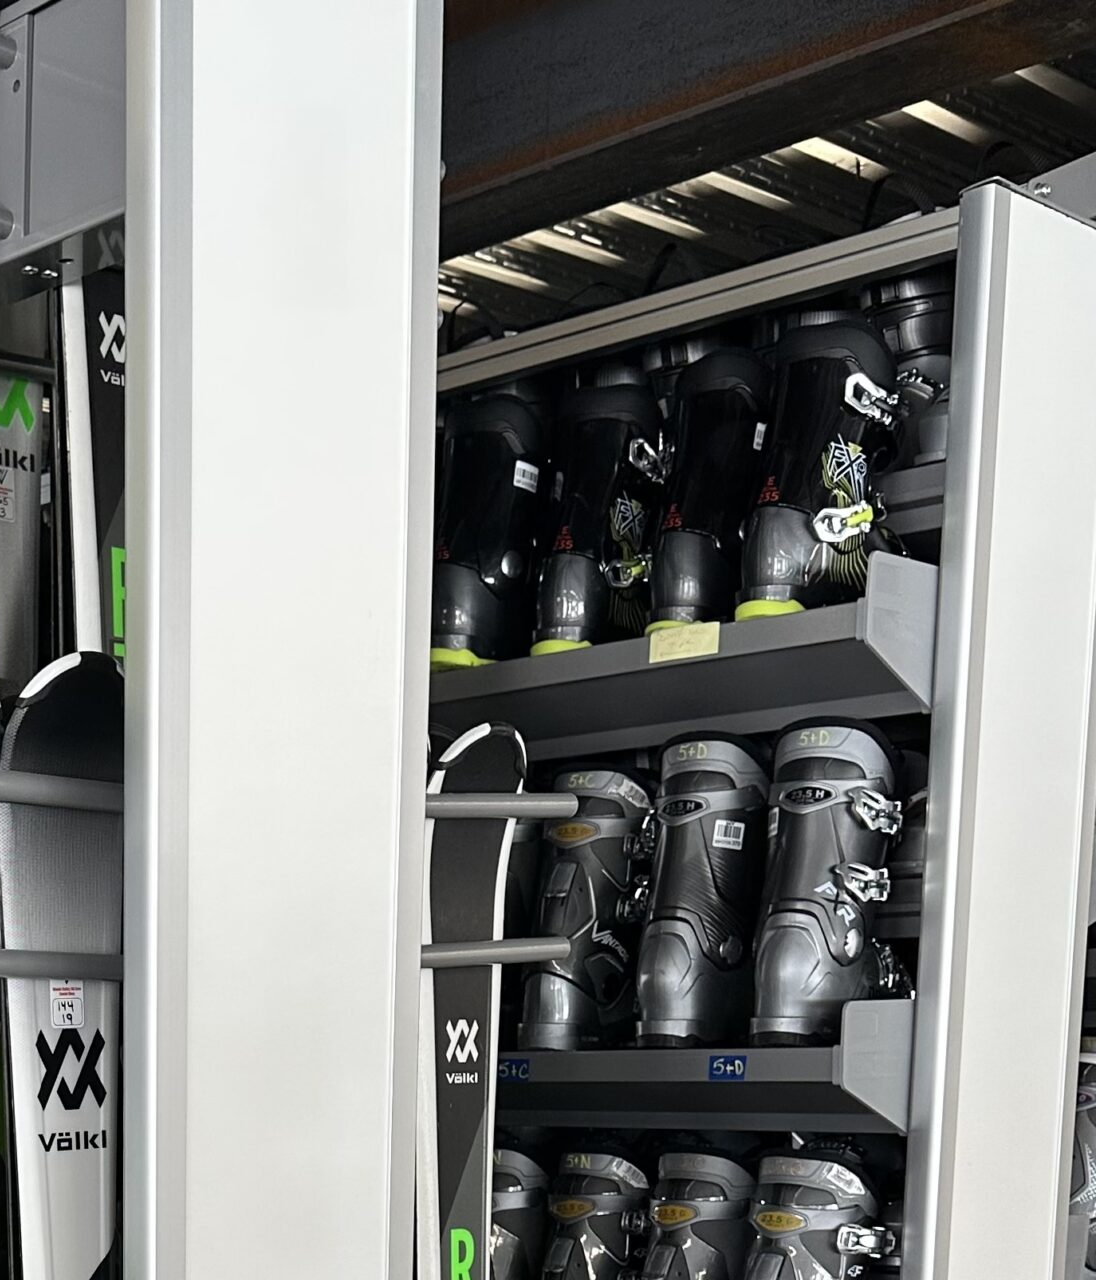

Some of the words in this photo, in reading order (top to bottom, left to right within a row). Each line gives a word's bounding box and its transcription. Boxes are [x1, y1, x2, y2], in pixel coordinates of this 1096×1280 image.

[100, 368, 126, 386] Völ
[799, 730, 830, 746] 5+D
[679, 744, 707, 760] 5+D
[567, 773, 595, 787] 5+C
[57, 999, 75, 1013] 144
[61, 1013, 74, 1025] 19
[499, 1063, 529, 1079] 5+C
[713, 1059, 744, 1075] 5+D
[446, 1072, 478, 1084] Völkl
[38, 1129, 107, 1152] Völkl
[566, 1154, 592, 1169] 5+N
